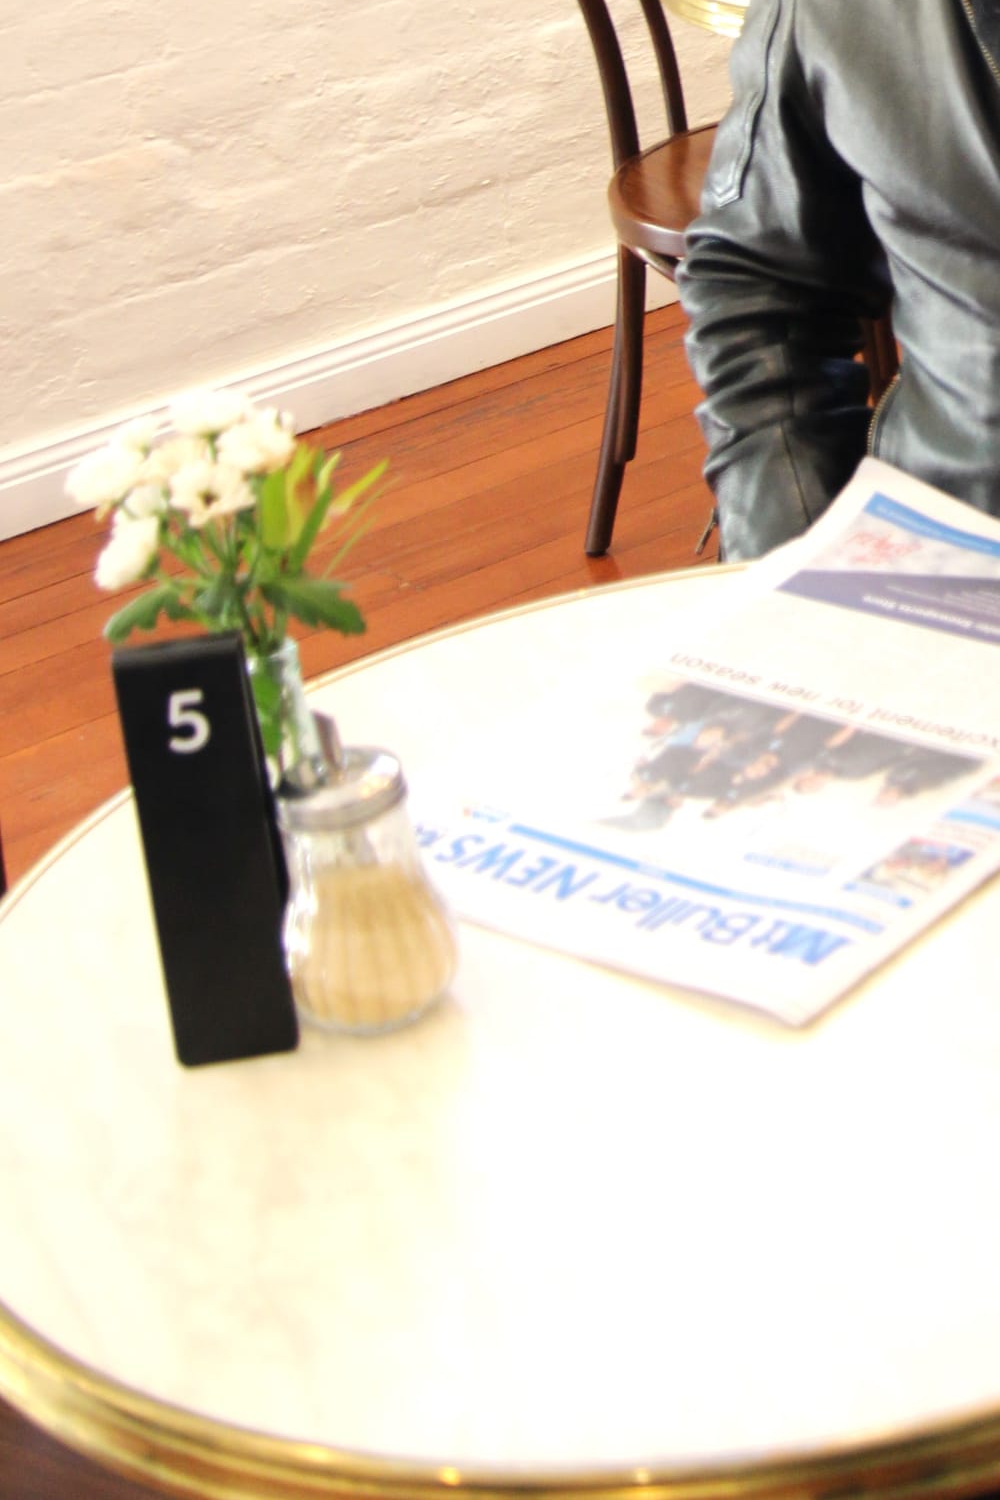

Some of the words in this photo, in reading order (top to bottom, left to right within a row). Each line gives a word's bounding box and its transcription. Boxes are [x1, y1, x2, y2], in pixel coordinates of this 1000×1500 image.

[668, 652, 763, 688] season
[770, 680, 822, 705] new
[168, 688, 210, 753] 5
[830, 695, 866, 718] for
[433, 833, 600, 902] NEWS
[586, 882, 760, 946] Buller
[750, 921, 852, 968] Mt
